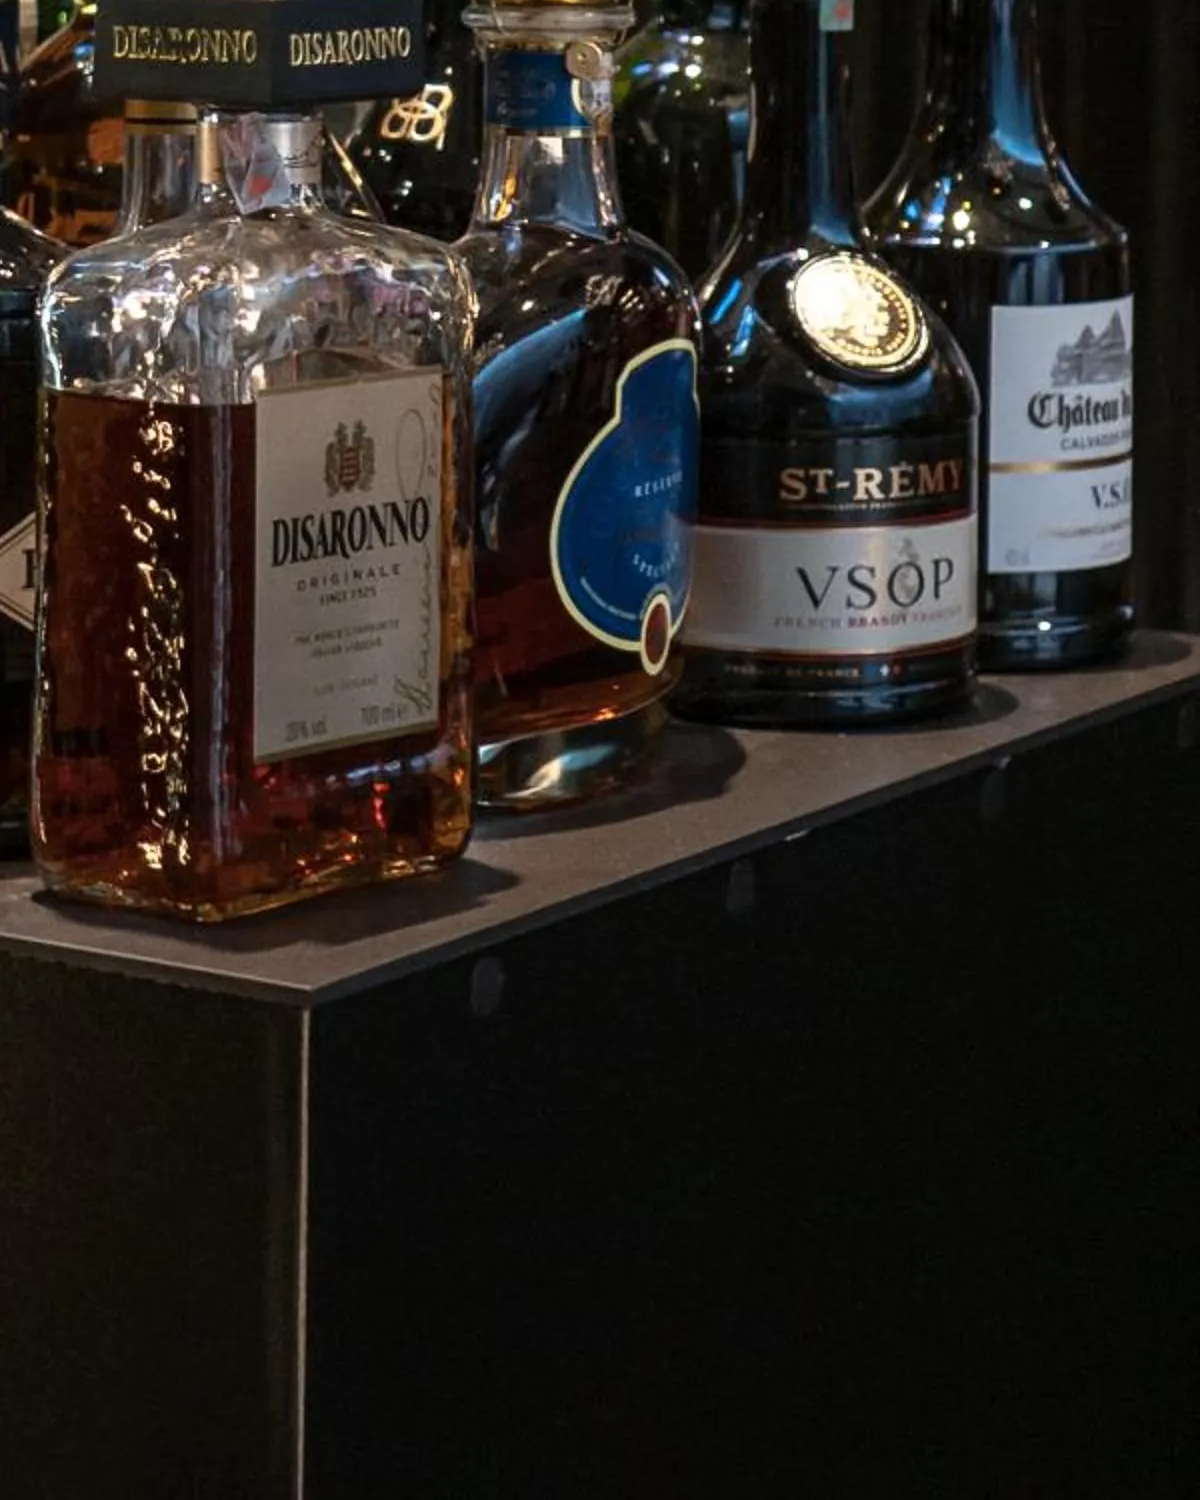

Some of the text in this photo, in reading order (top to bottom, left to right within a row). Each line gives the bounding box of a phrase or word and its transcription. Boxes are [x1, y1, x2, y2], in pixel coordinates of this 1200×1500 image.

[112, 25, 258, 64] DISARONNO
[289, 27, 411, 66] DISARONNO
[1027, 389, 1120, 434] Château
[270, 496, 430, 568] DISARONNO
[297, 563, 401, 592] ORIGINALE
[796, 556, 955, 612] VSOP
[847, 614, 908, 630] BRANDY
